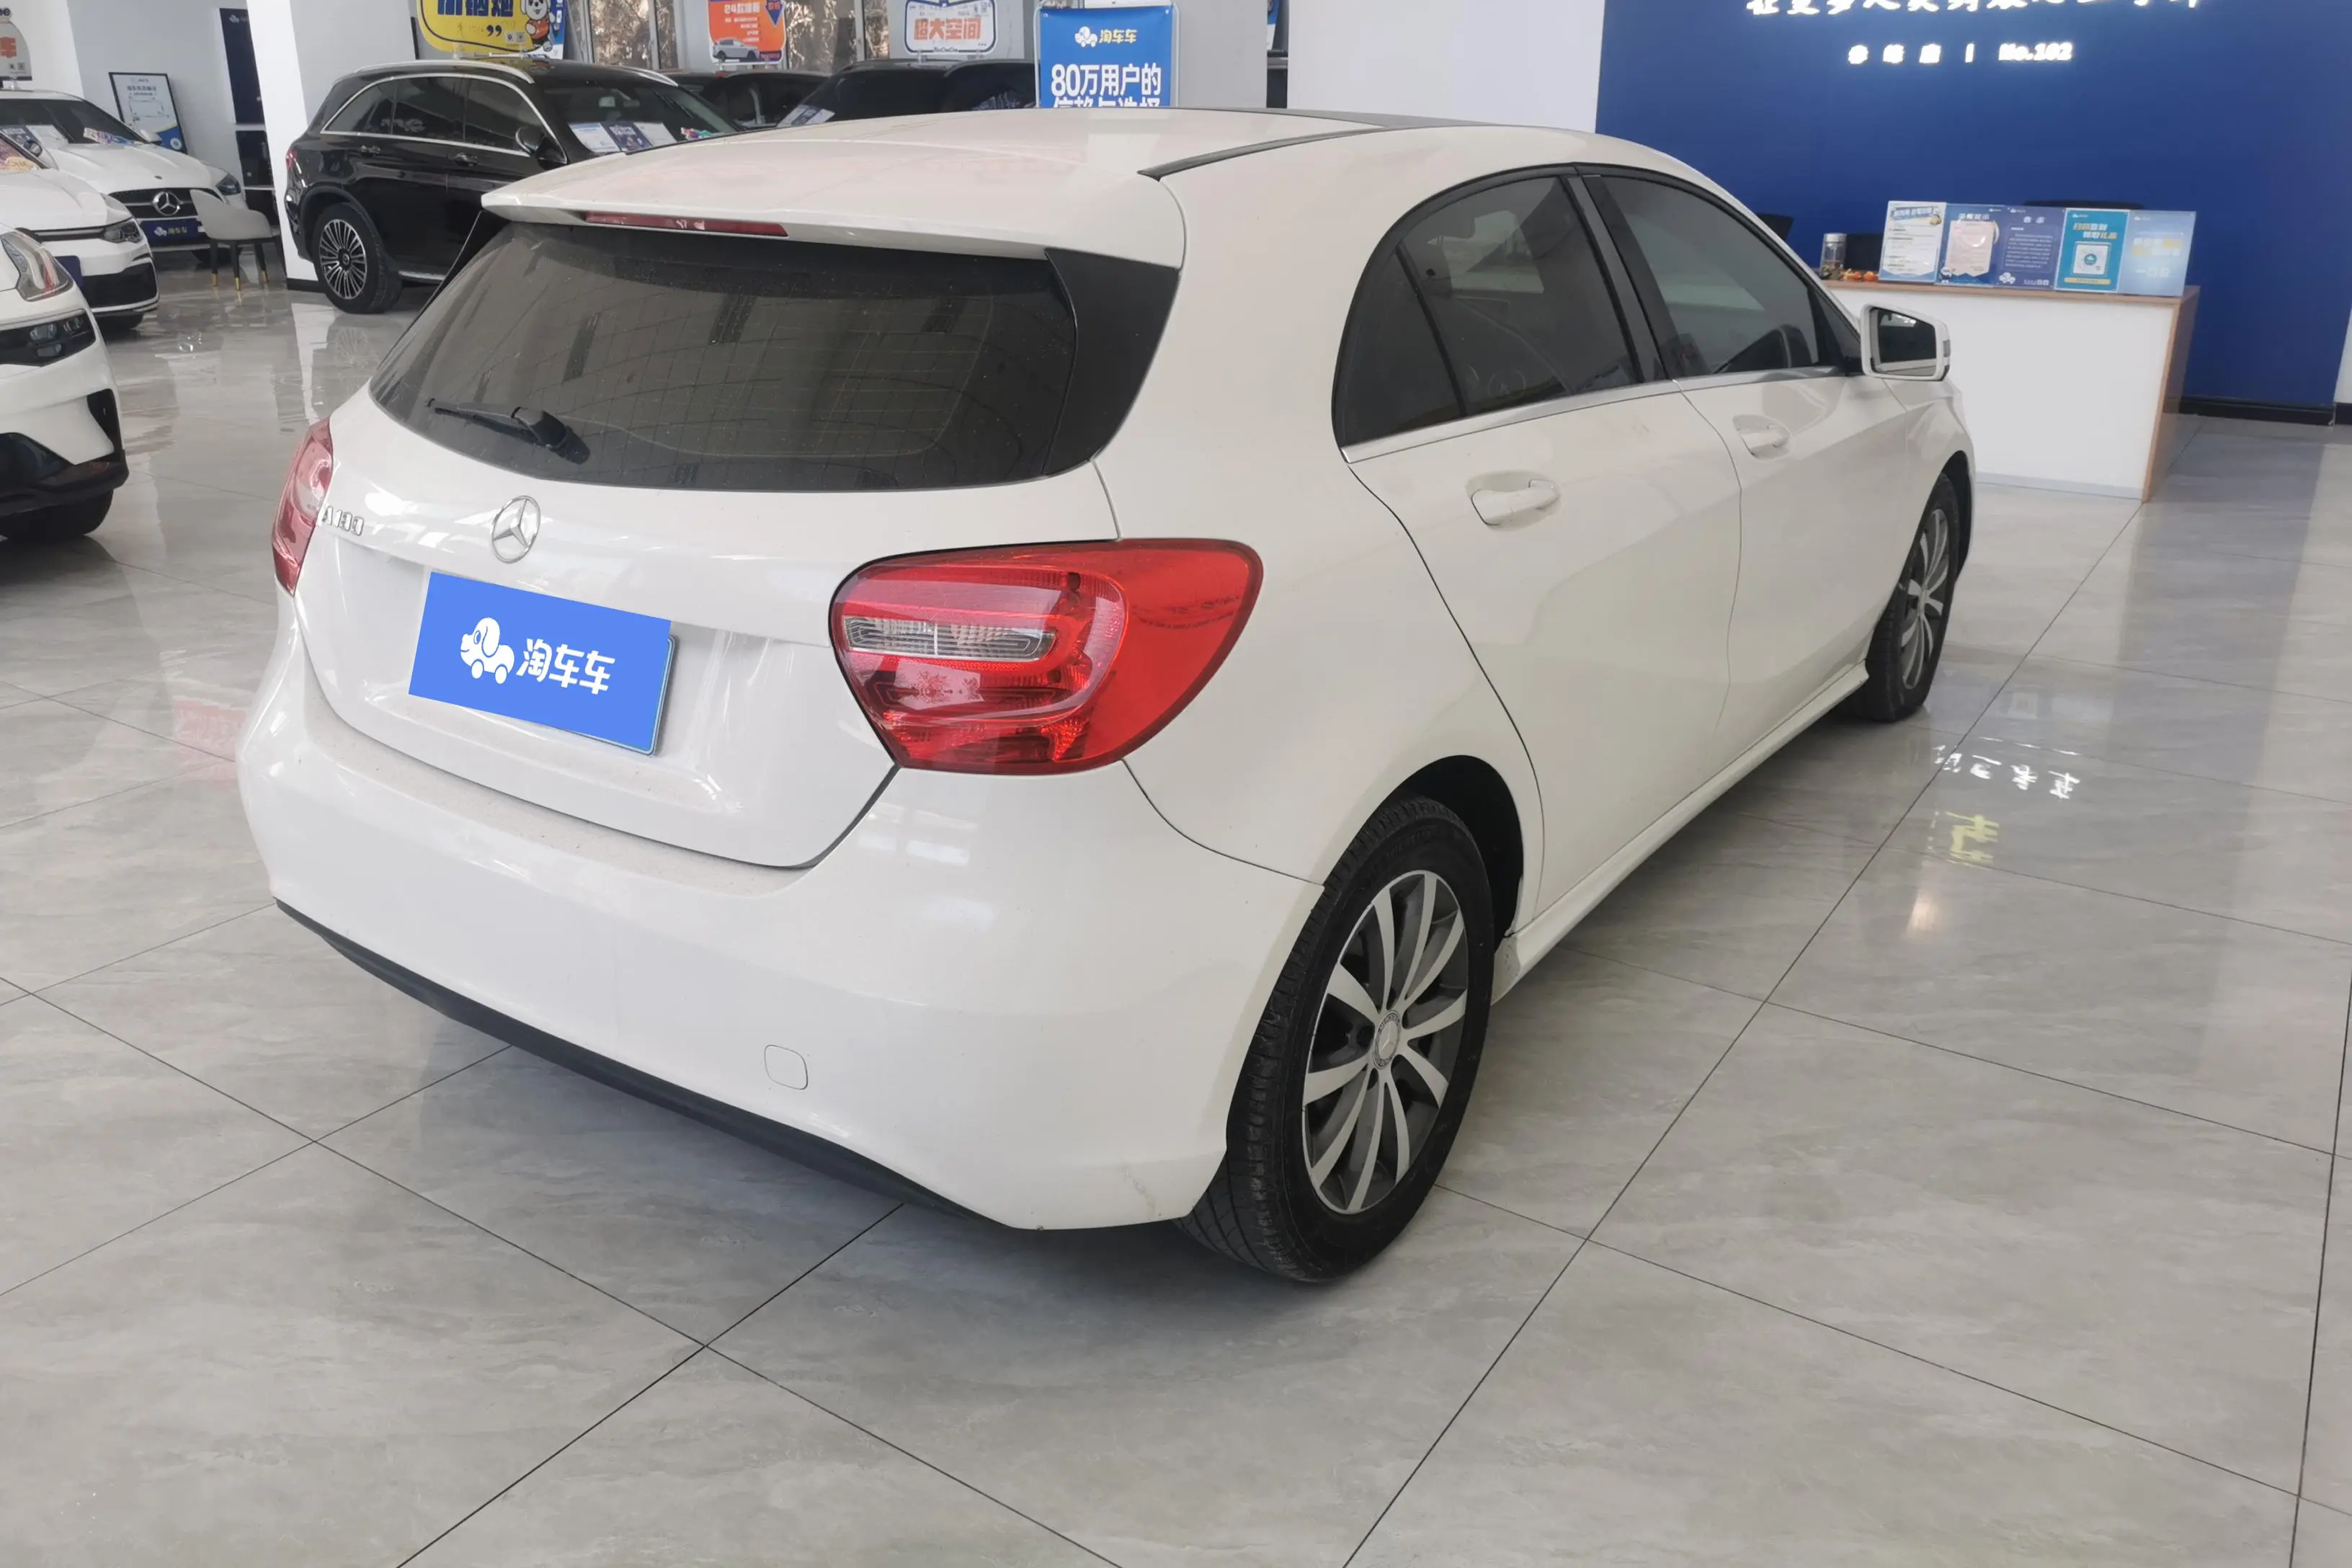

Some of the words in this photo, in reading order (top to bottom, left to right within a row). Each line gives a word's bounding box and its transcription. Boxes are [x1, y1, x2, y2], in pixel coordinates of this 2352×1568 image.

[1099, 29, 1137, 44] 淘车车
[1051, 63, 1162, 97] 80万用户的
